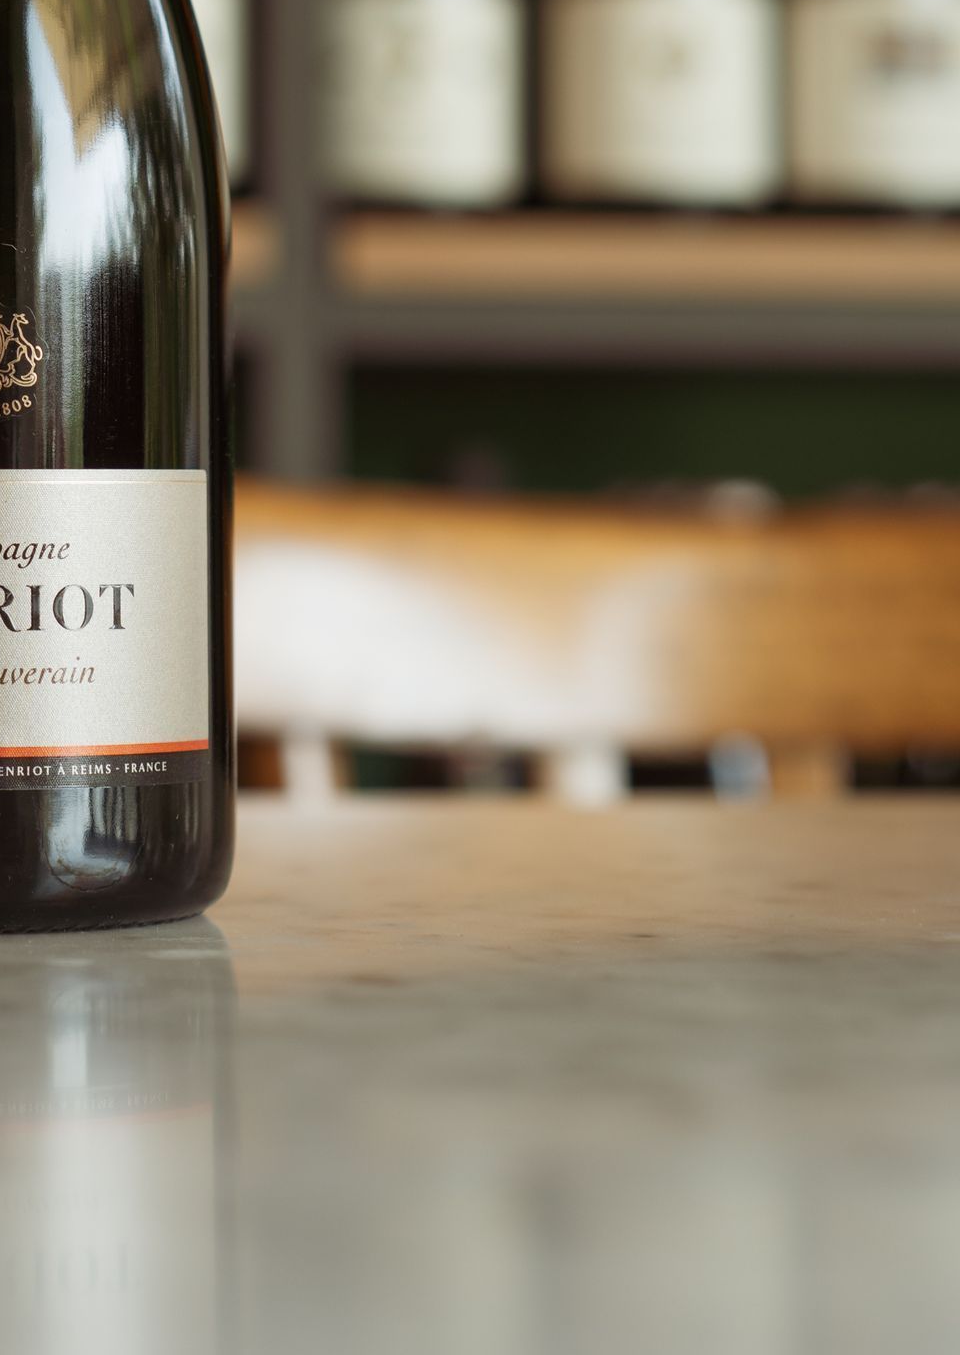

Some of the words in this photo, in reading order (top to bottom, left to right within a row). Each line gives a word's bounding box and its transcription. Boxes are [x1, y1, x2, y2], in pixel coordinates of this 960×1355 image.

[57, 762, 66, 776] À
[71, 762, 112, 776] REIMS
[124, 760, 168, 774] FRANCE
